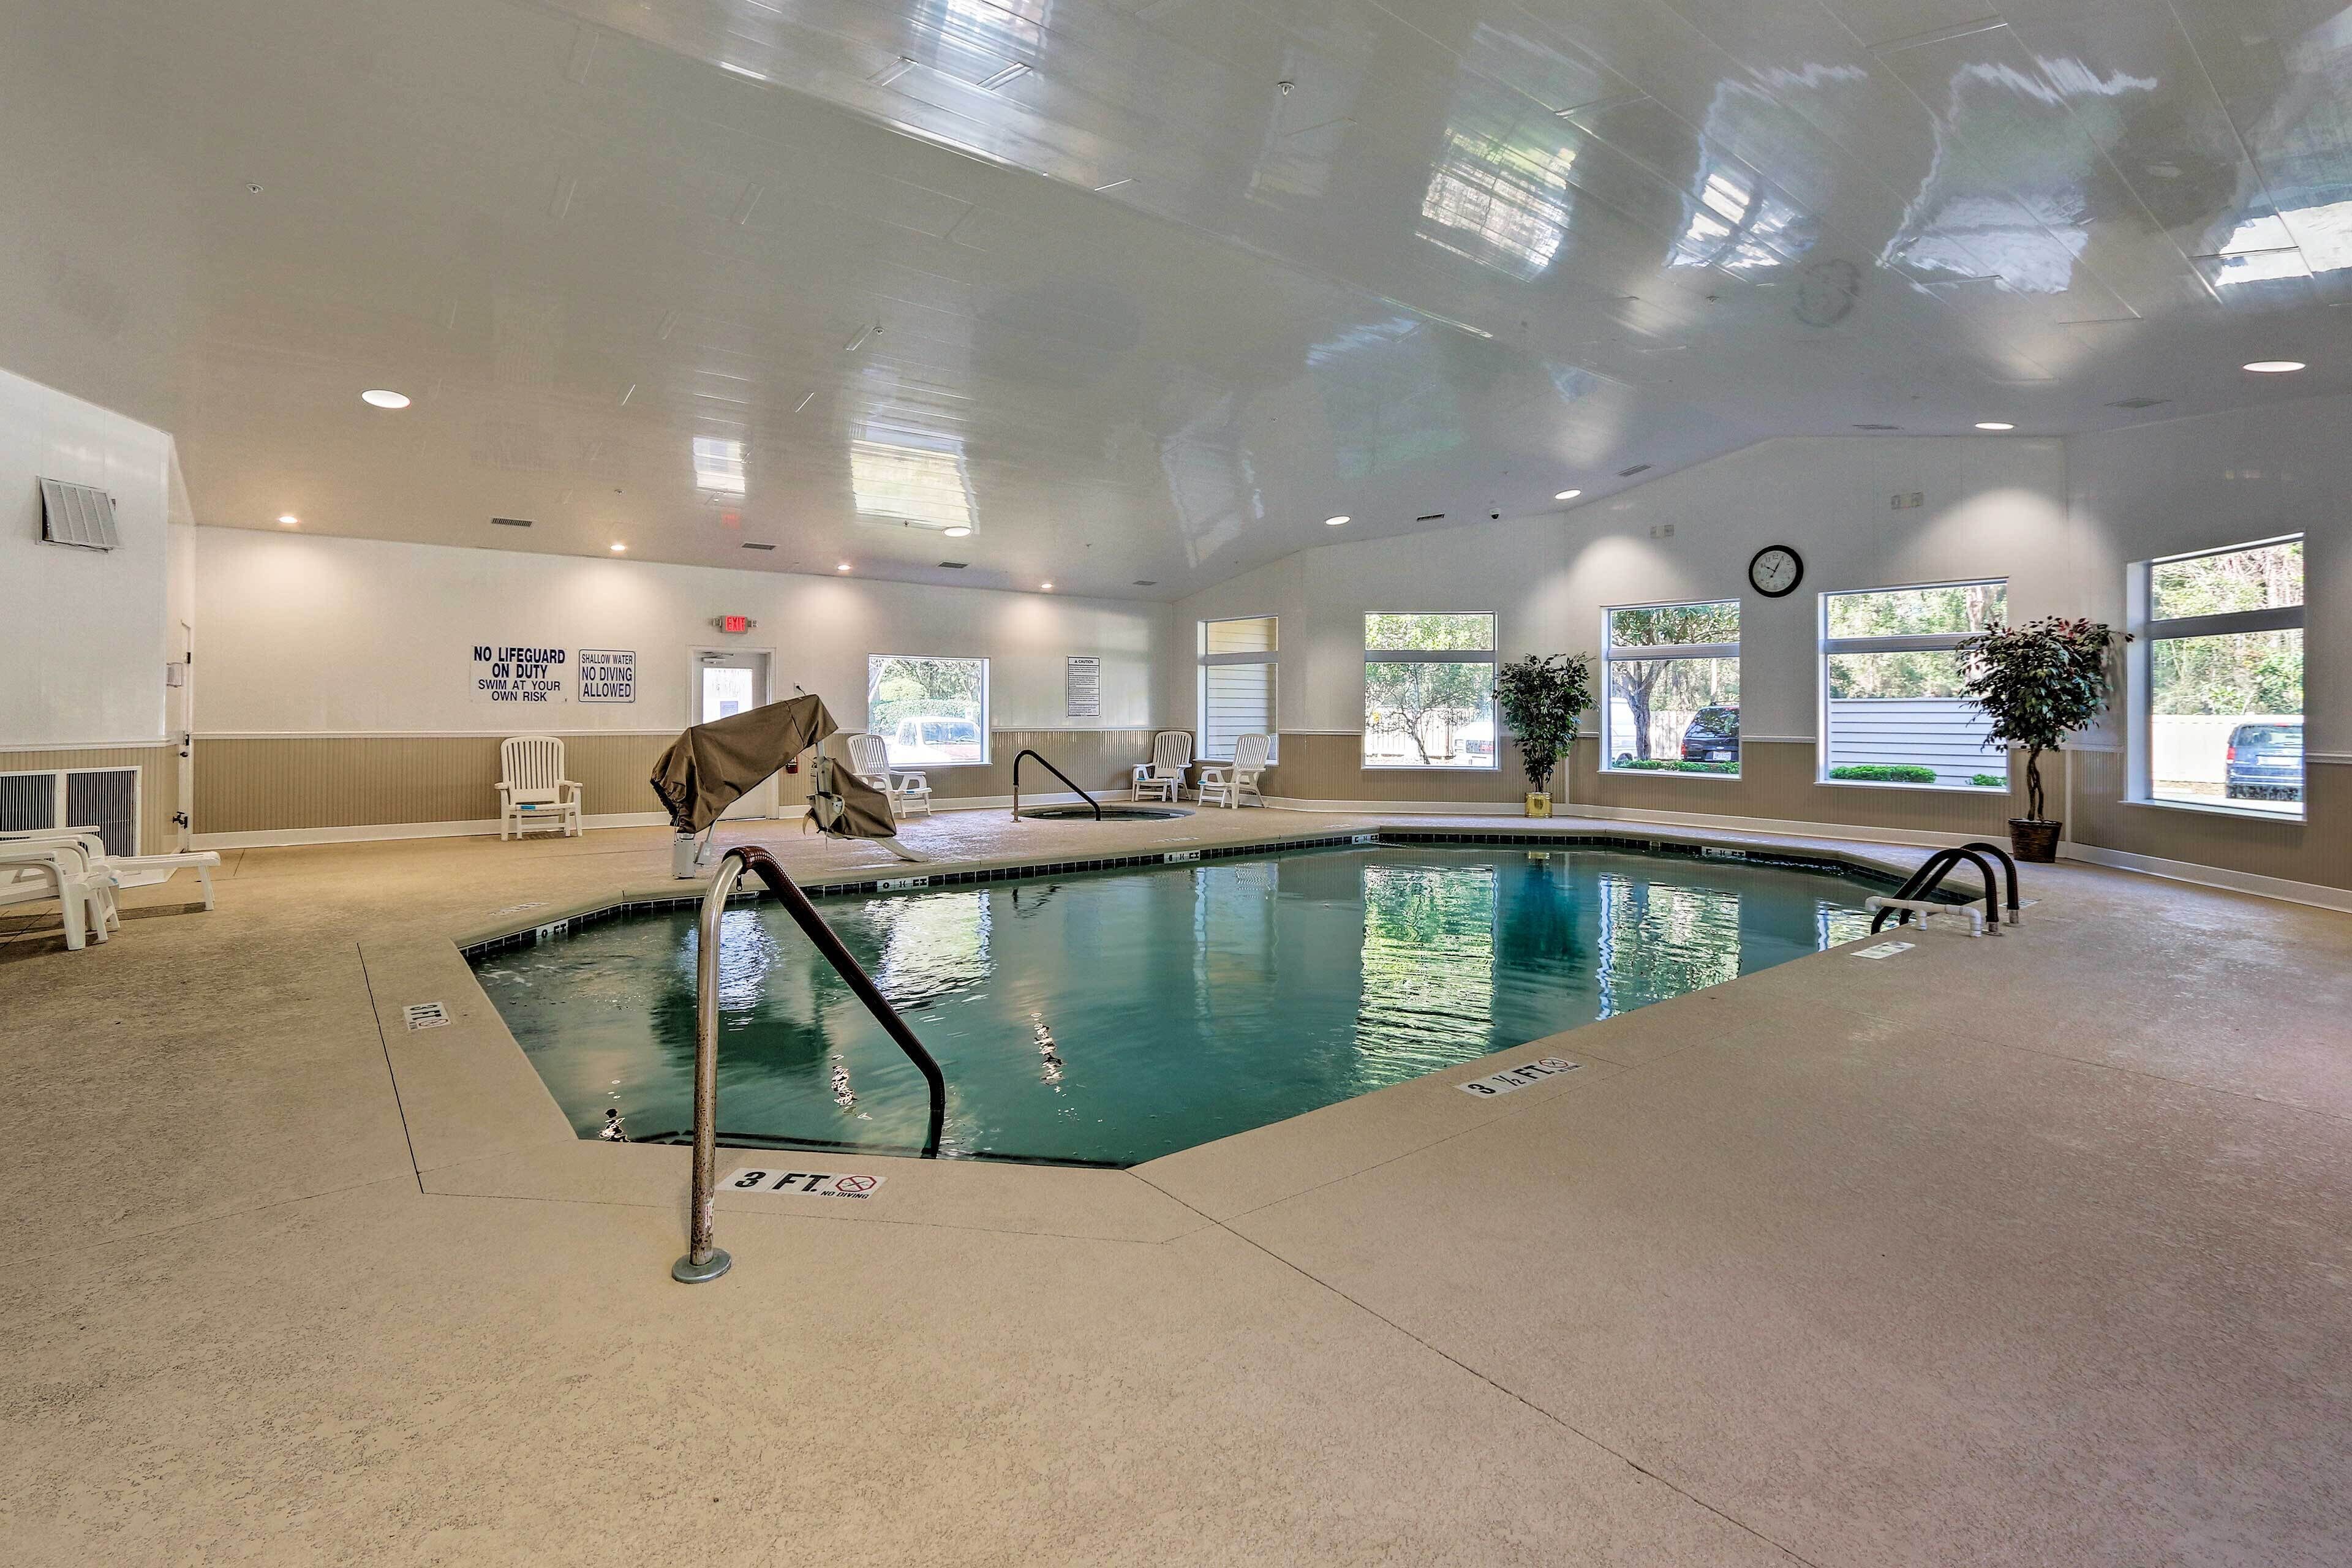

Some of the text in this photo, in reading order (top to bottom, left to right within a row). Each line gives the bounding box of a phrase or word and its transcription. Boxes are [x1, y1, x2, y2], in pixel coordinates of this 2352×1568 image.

[727, 617, 745, 630] EXIT
[474, 646, 565, 664] NO LIFEGUARD
[582, 654, 633, 665] SHALLOW WATER
[492, 663, 548, 679] ON DUTY
[582, 666, 632, 682] NO DIVING
[478, 679, 560, 691] SWIM AT YOUR
[583, 682, 631, 698] ALLOWED
[492, 691, 547, 702] OWN RISK
[1468, 1084, 1496, 1095] 3
[735, 1171, 831, 1193] 3 FT.
